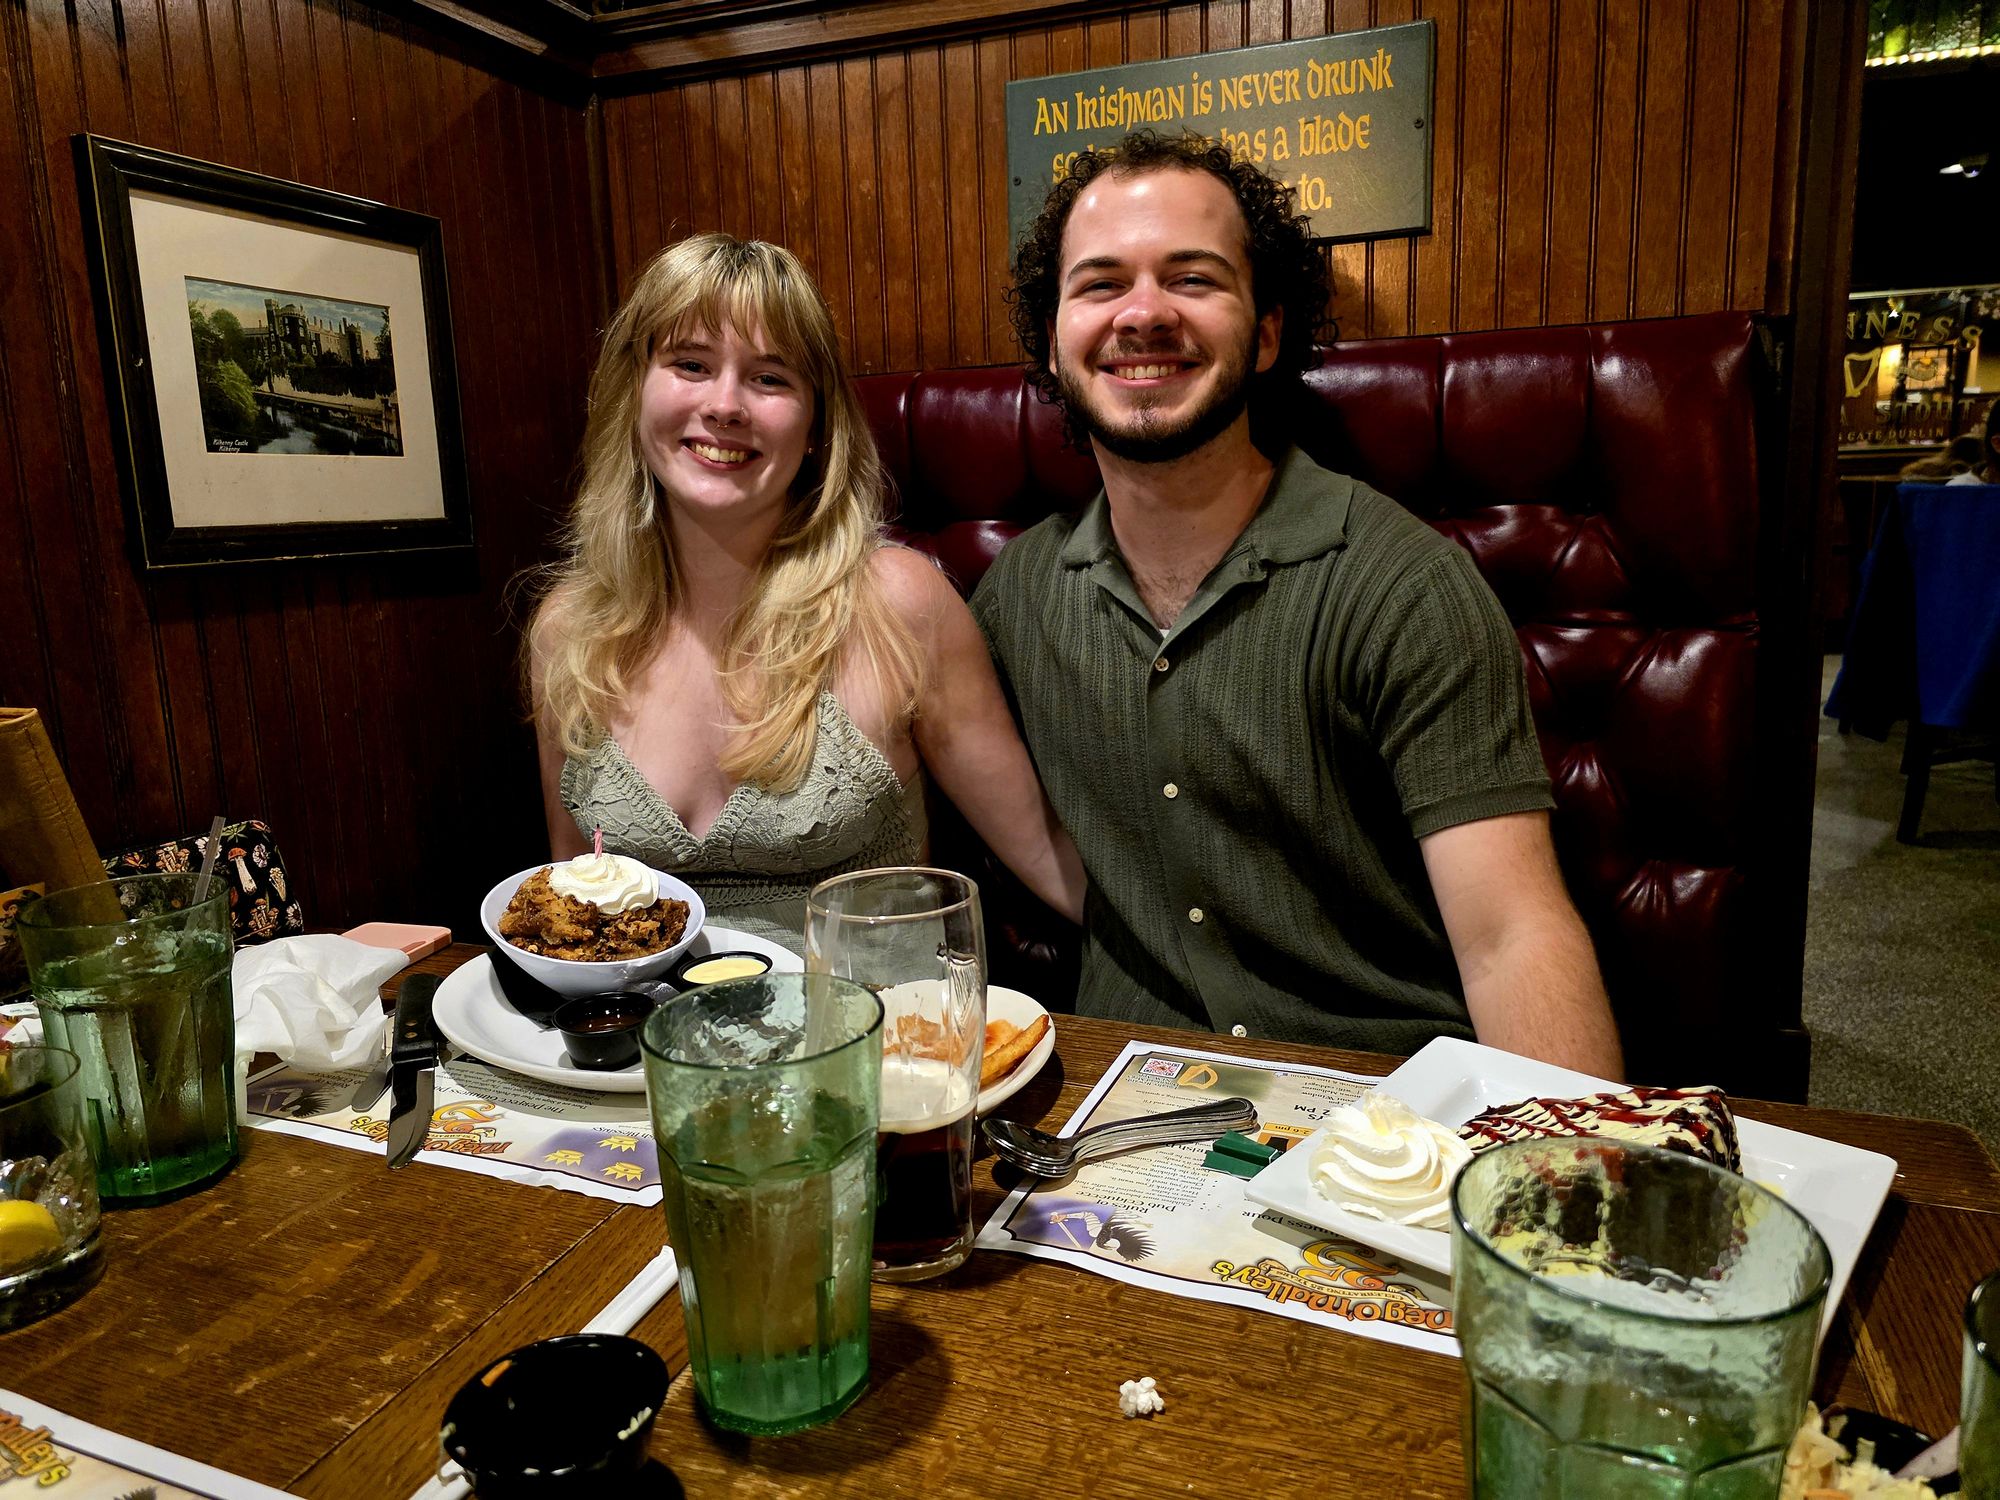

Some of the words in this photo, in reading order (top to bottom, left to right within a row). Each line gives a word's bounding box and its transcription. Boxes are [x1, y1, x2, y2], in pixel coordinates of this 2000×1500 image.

[1033, 96, 1069, 136] An
[1075, 83, 1186, 132] Irishman
[1191, 71, 1213, 117] is
[1220, 68, 1301, 113] never
[1306, 47, 1396, 100] drunk
[1273, 126, 1291, 161] a
[1299, 113, 1371, 157] blade
[1299, 174, 1332, 211] to.
[1846, 310, 1984, 350] NESS
[543, 1105, 565, 1114] The
[1292, 1104, 1316, 1112] PM
[1109, 1202, 1148, 1213] Rules
[1145, 1201, 1176, 1211] Pub
[1160, 1198, 1192, 1206] Children
